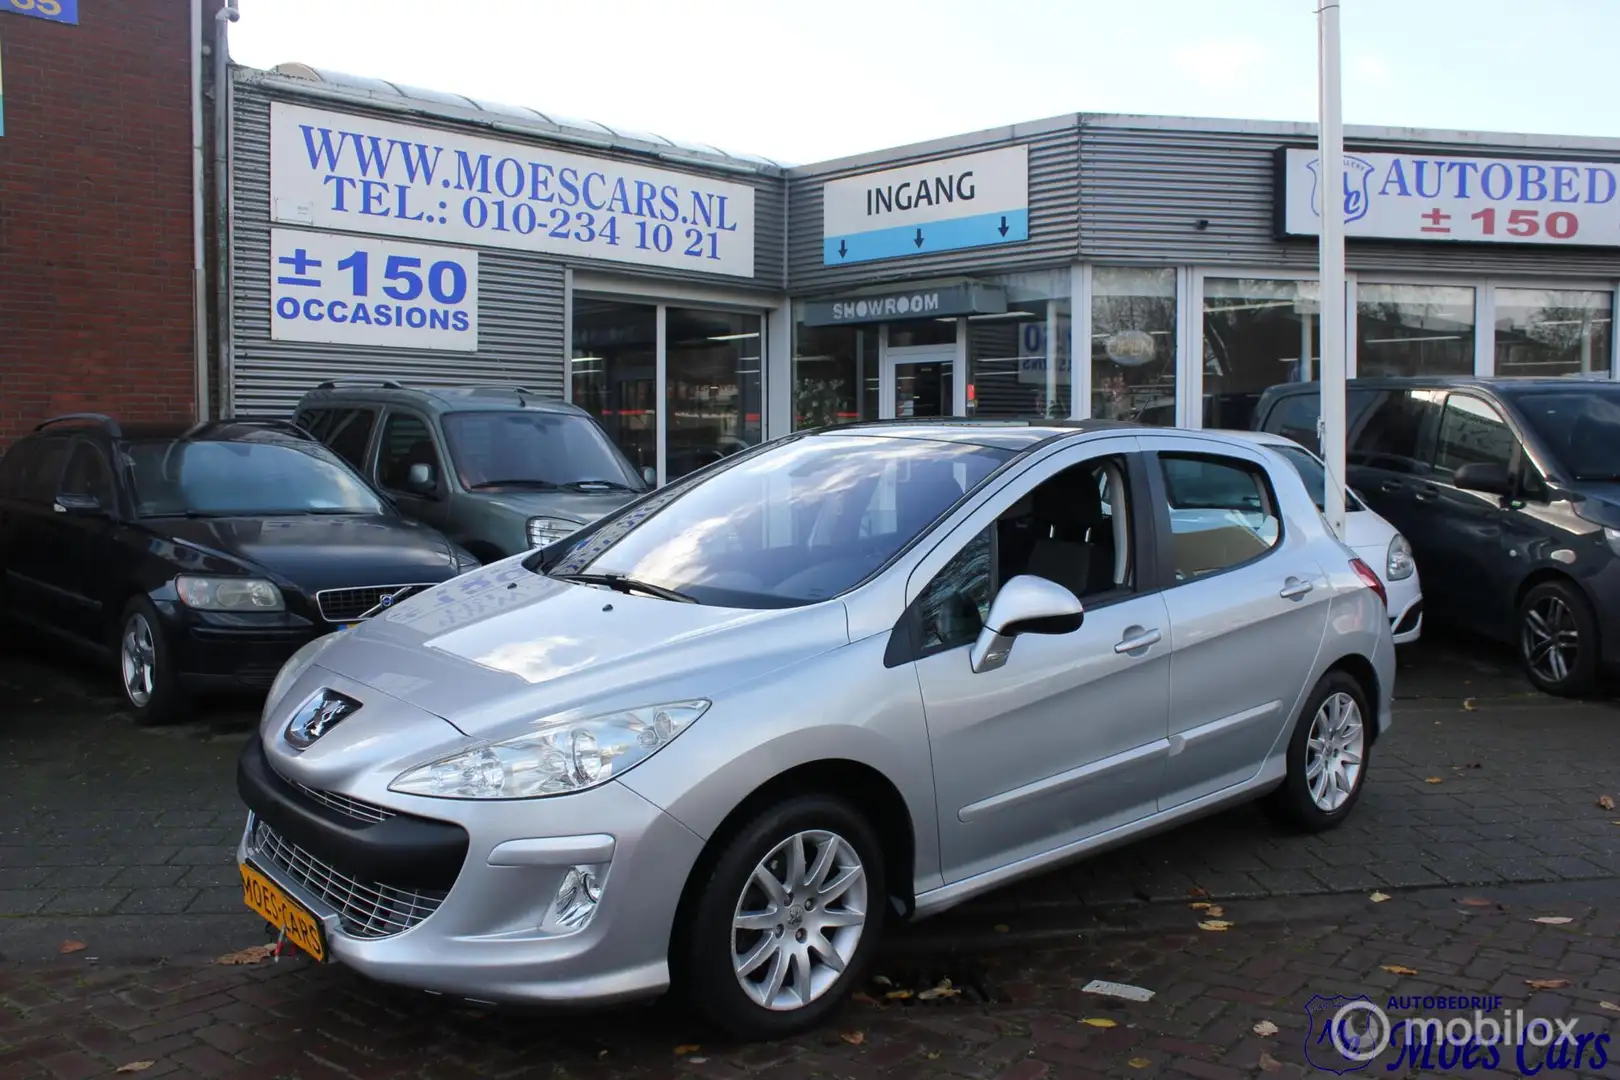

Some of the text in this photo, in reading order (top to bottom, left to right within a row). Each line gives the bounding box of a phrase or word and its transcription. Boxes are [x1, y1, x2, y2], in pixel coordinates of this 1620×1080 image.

[298, 124, 738, 232] WWW.MOESCARS.NL
[866, 171, 976, 216] INGANG
[323, 174, 721, 260] TEL.: 010-234 10 21
[276, 296, 470, 332] OCCASIONS
[831, 292, 939, 320] SHOWROOM
